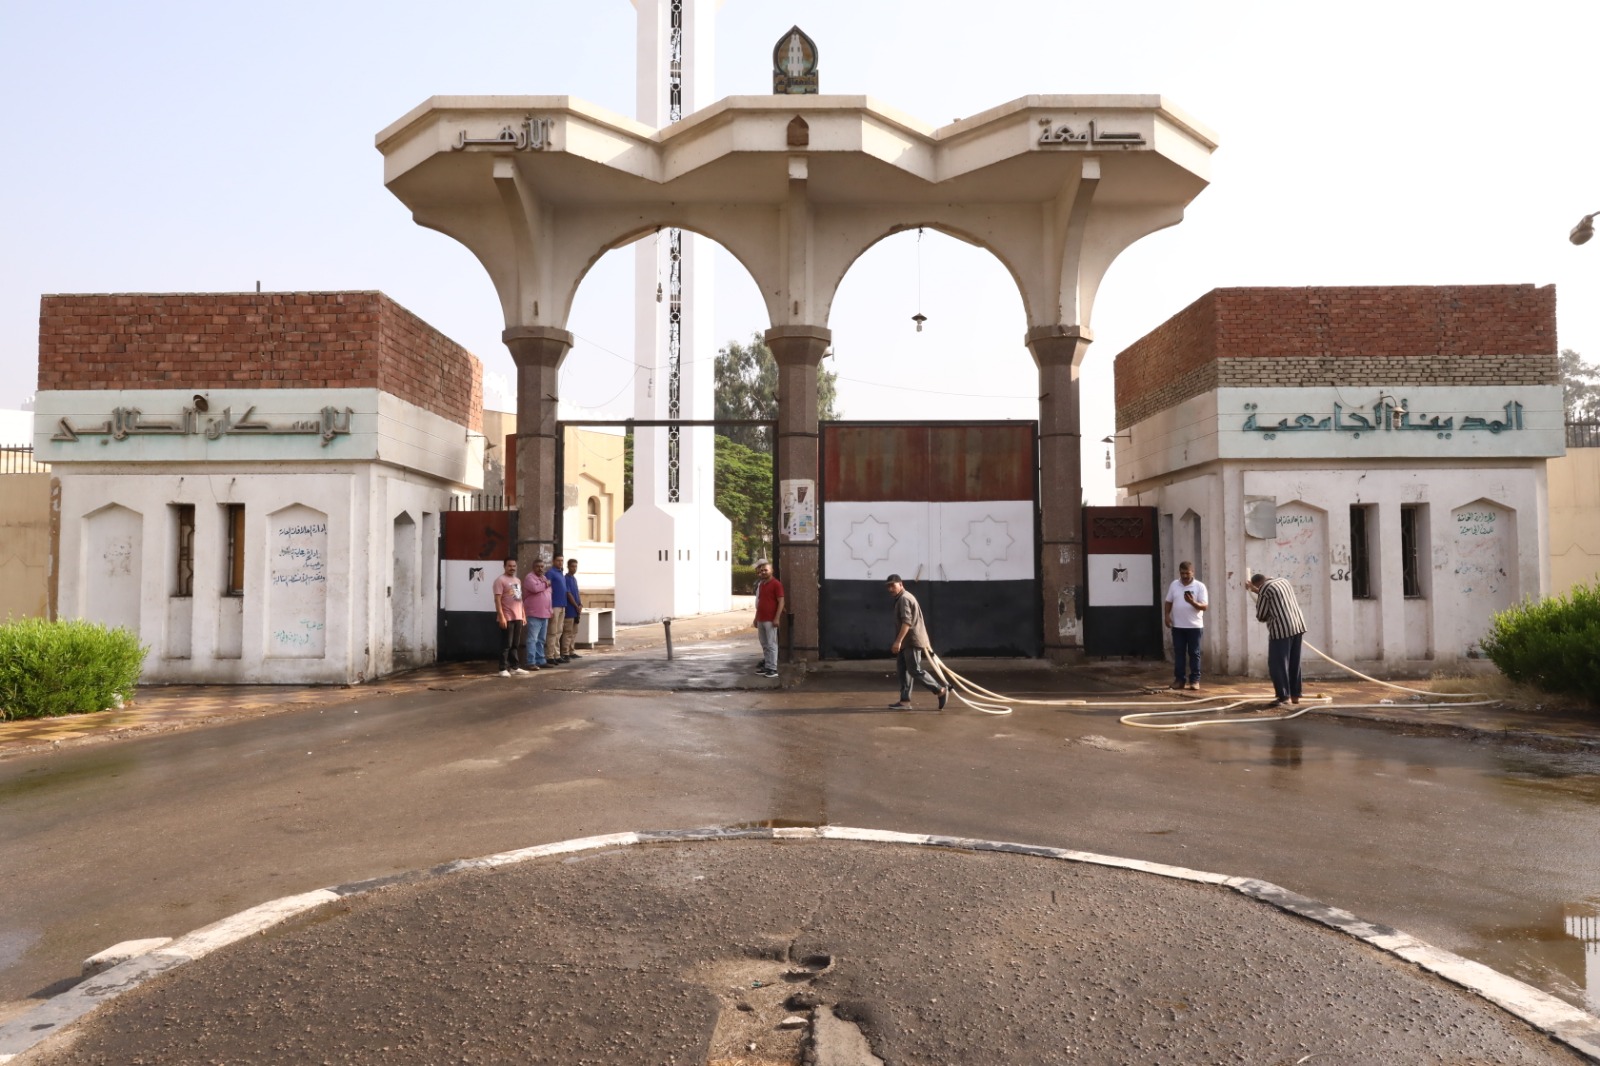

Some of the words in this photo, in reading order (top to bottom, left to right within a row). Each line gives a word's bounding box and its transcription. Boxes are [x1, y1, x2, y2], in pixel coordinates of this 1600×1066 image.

[451, 113, 555, 150] الأزهر
[1038, 117, 1147, 150] جامعة
[1243, 401, 1392, 440] الجامعية
[1396, 398, 1524, 440] المدينة
